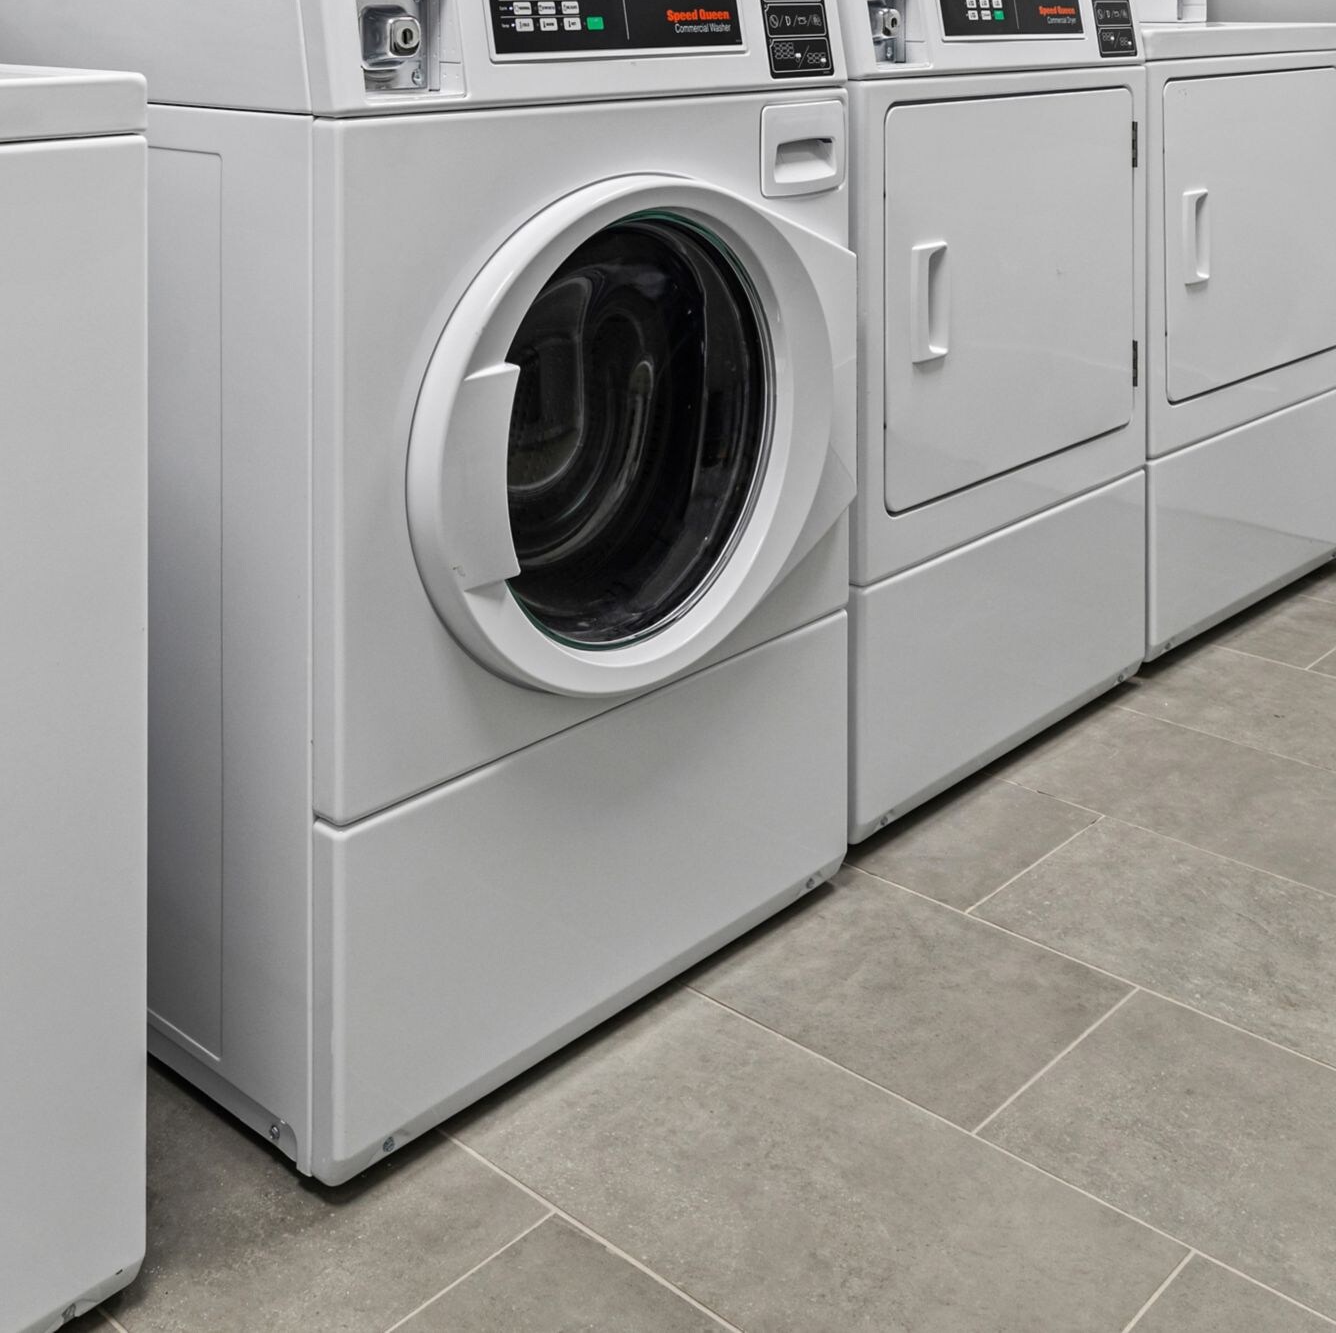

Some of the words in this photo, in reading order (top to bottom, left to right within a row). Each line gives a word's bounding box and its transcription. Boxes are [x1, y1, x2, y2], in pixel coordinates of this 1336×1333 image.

[667, 9, 698, 22] Speed
[699, 9, 730, 20] Queen
[1039, 6, 1057, 16] Speed
[675, 23, 709, 33] Commercial
[710, 23, 731, 32] Washer
